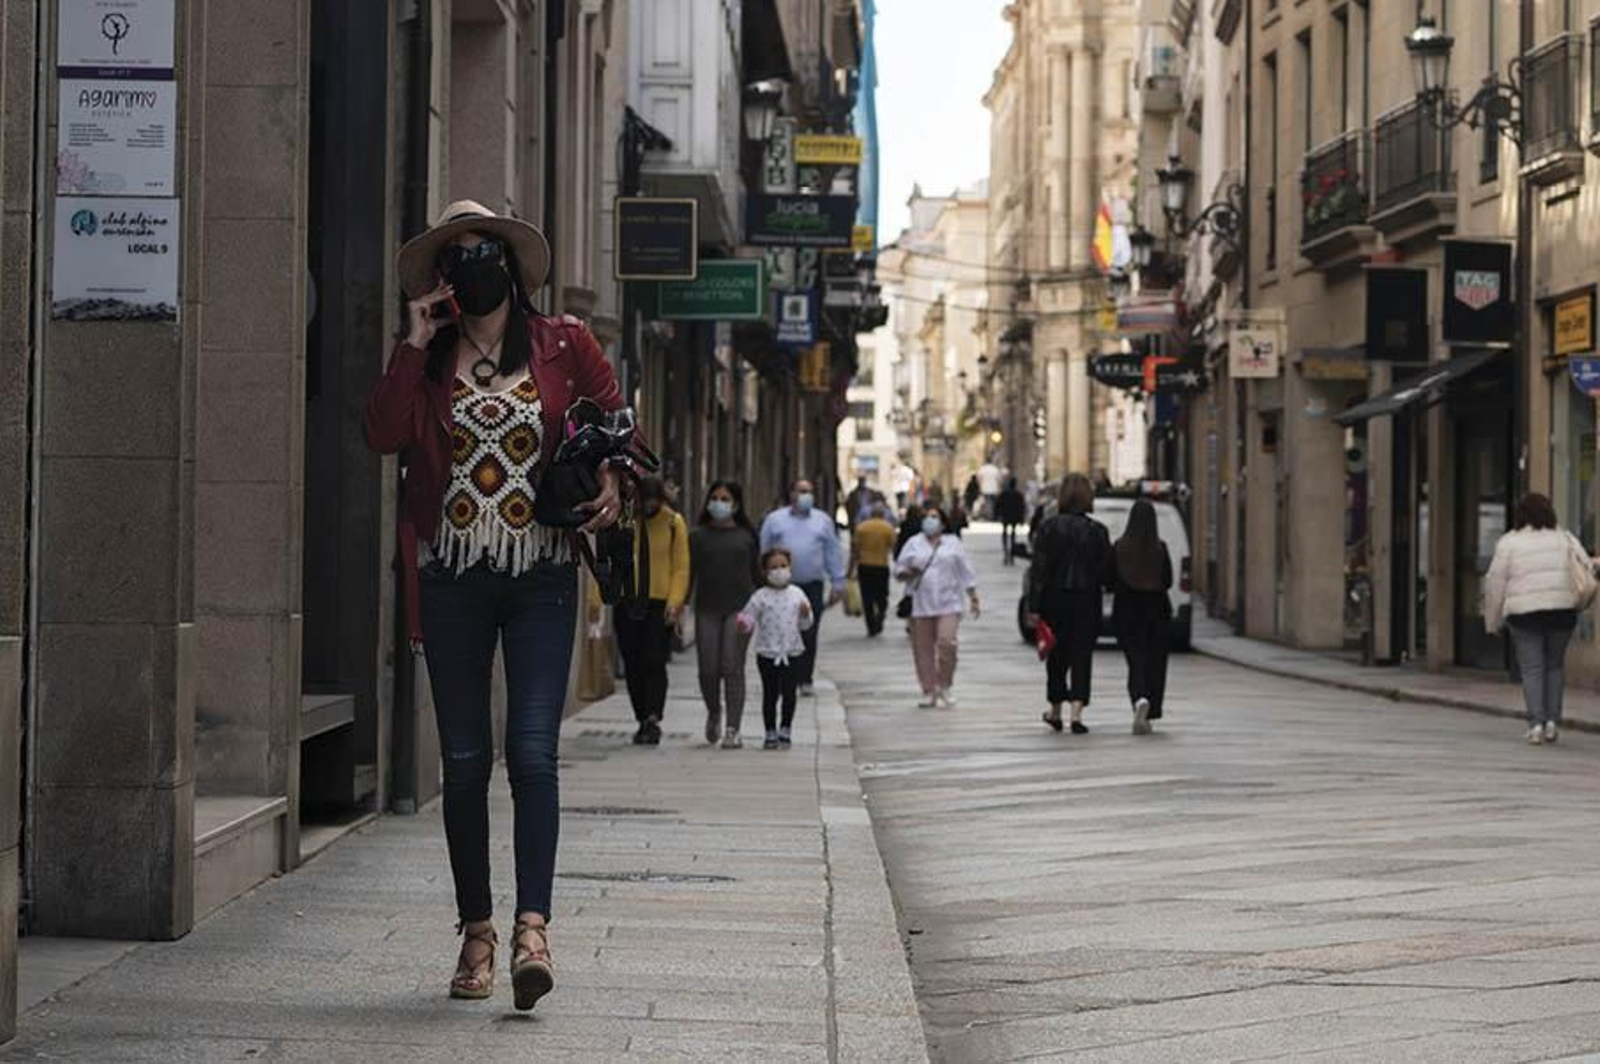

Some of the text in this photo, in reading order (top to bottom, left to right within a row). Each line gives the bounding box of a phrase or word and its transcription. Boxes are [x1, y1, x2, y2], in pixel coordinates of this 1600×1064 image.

[129, 212, 169, 229] alpino
[128, 243, 168, 254] LOCAL 9
[1460, 273, 1496, 286] TAG
